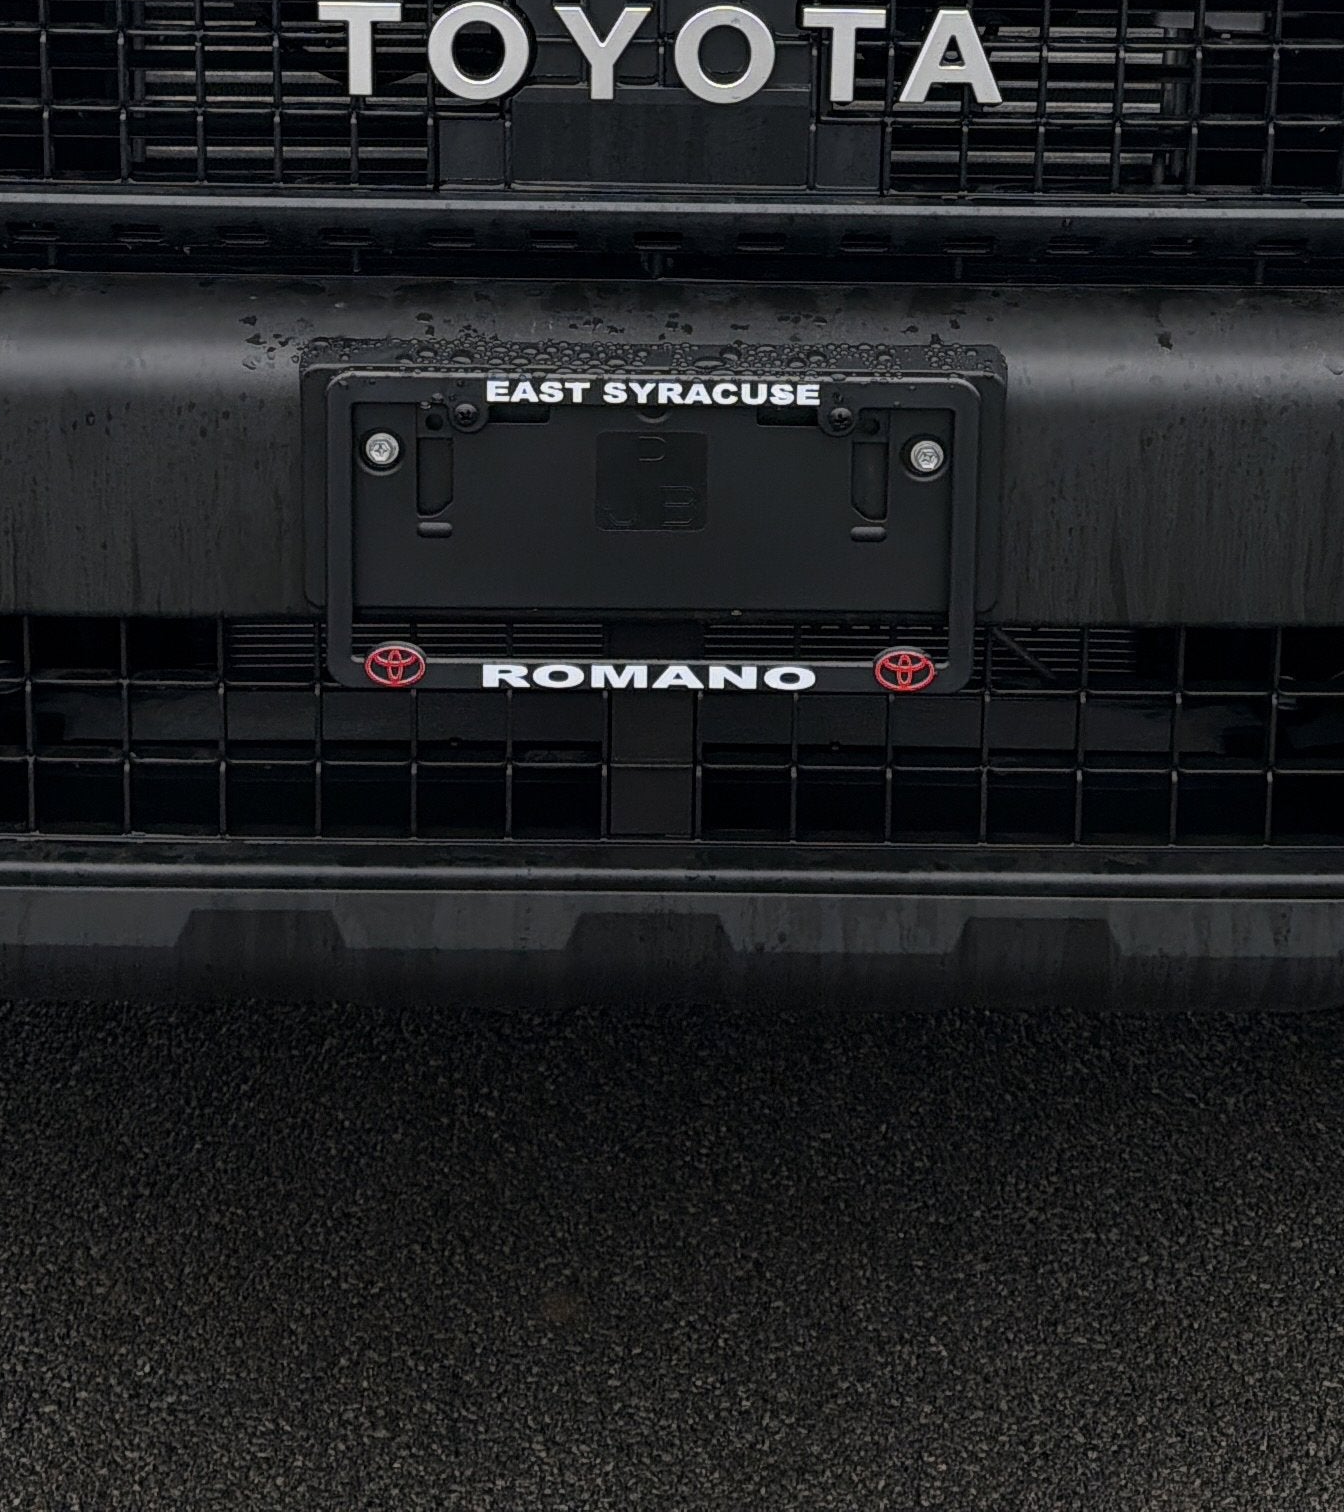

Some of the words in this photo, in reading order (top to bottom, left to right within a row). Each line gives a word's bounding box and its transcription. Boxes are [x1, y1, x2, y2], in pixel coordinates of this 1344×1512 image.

[317, 1, 1003, 105] TOYOTA
[486, 380, 591, 403] EAST
[603, 382, 821, 406] SYRACUSE
[482, 664, 816, 691] ROMANO
